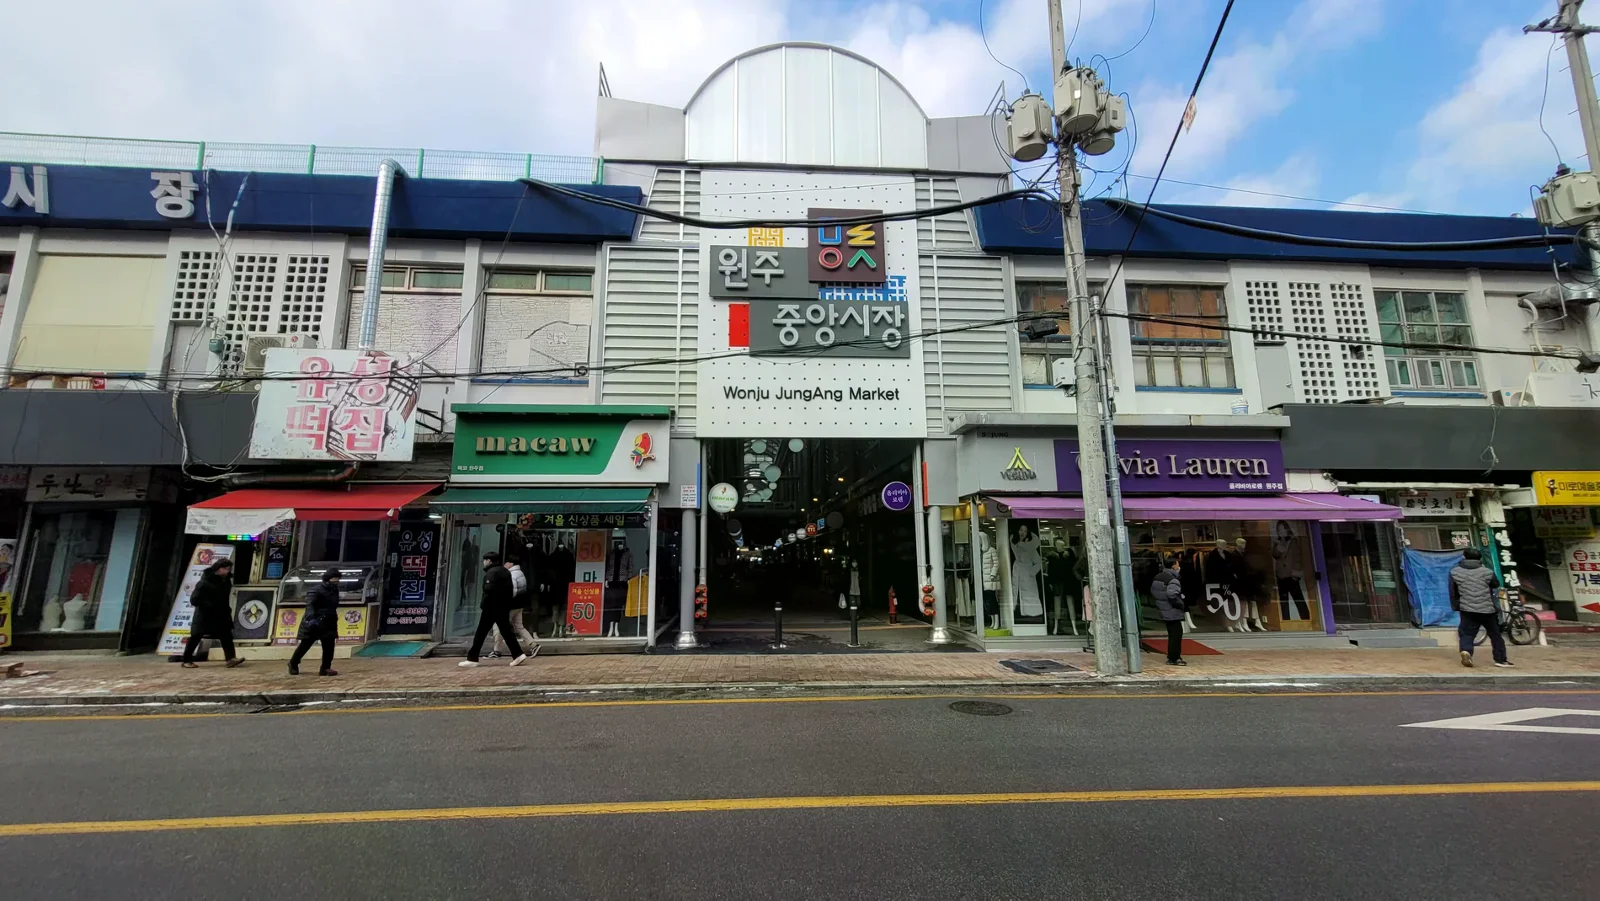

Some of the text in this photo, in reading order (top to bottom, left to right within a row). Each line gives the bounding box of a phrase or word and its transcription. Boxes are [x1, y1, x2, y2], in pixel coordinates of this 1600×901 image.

[718, 248, 785, 290] 원주
[772, 302, 906, 348] 중앙시장
[723, 385, 900, 402] Wonju JungAng Market
[285, 404, 390, 453] 떡집
[475, 436, 597, 454] macaw
[1169, 453, 1271, 476] Lauren
[543, 514, 625, 527] 겨울 신상품 세일
[398, 530, 433, 553] 유성
[572, 602, 595, 620] 50
